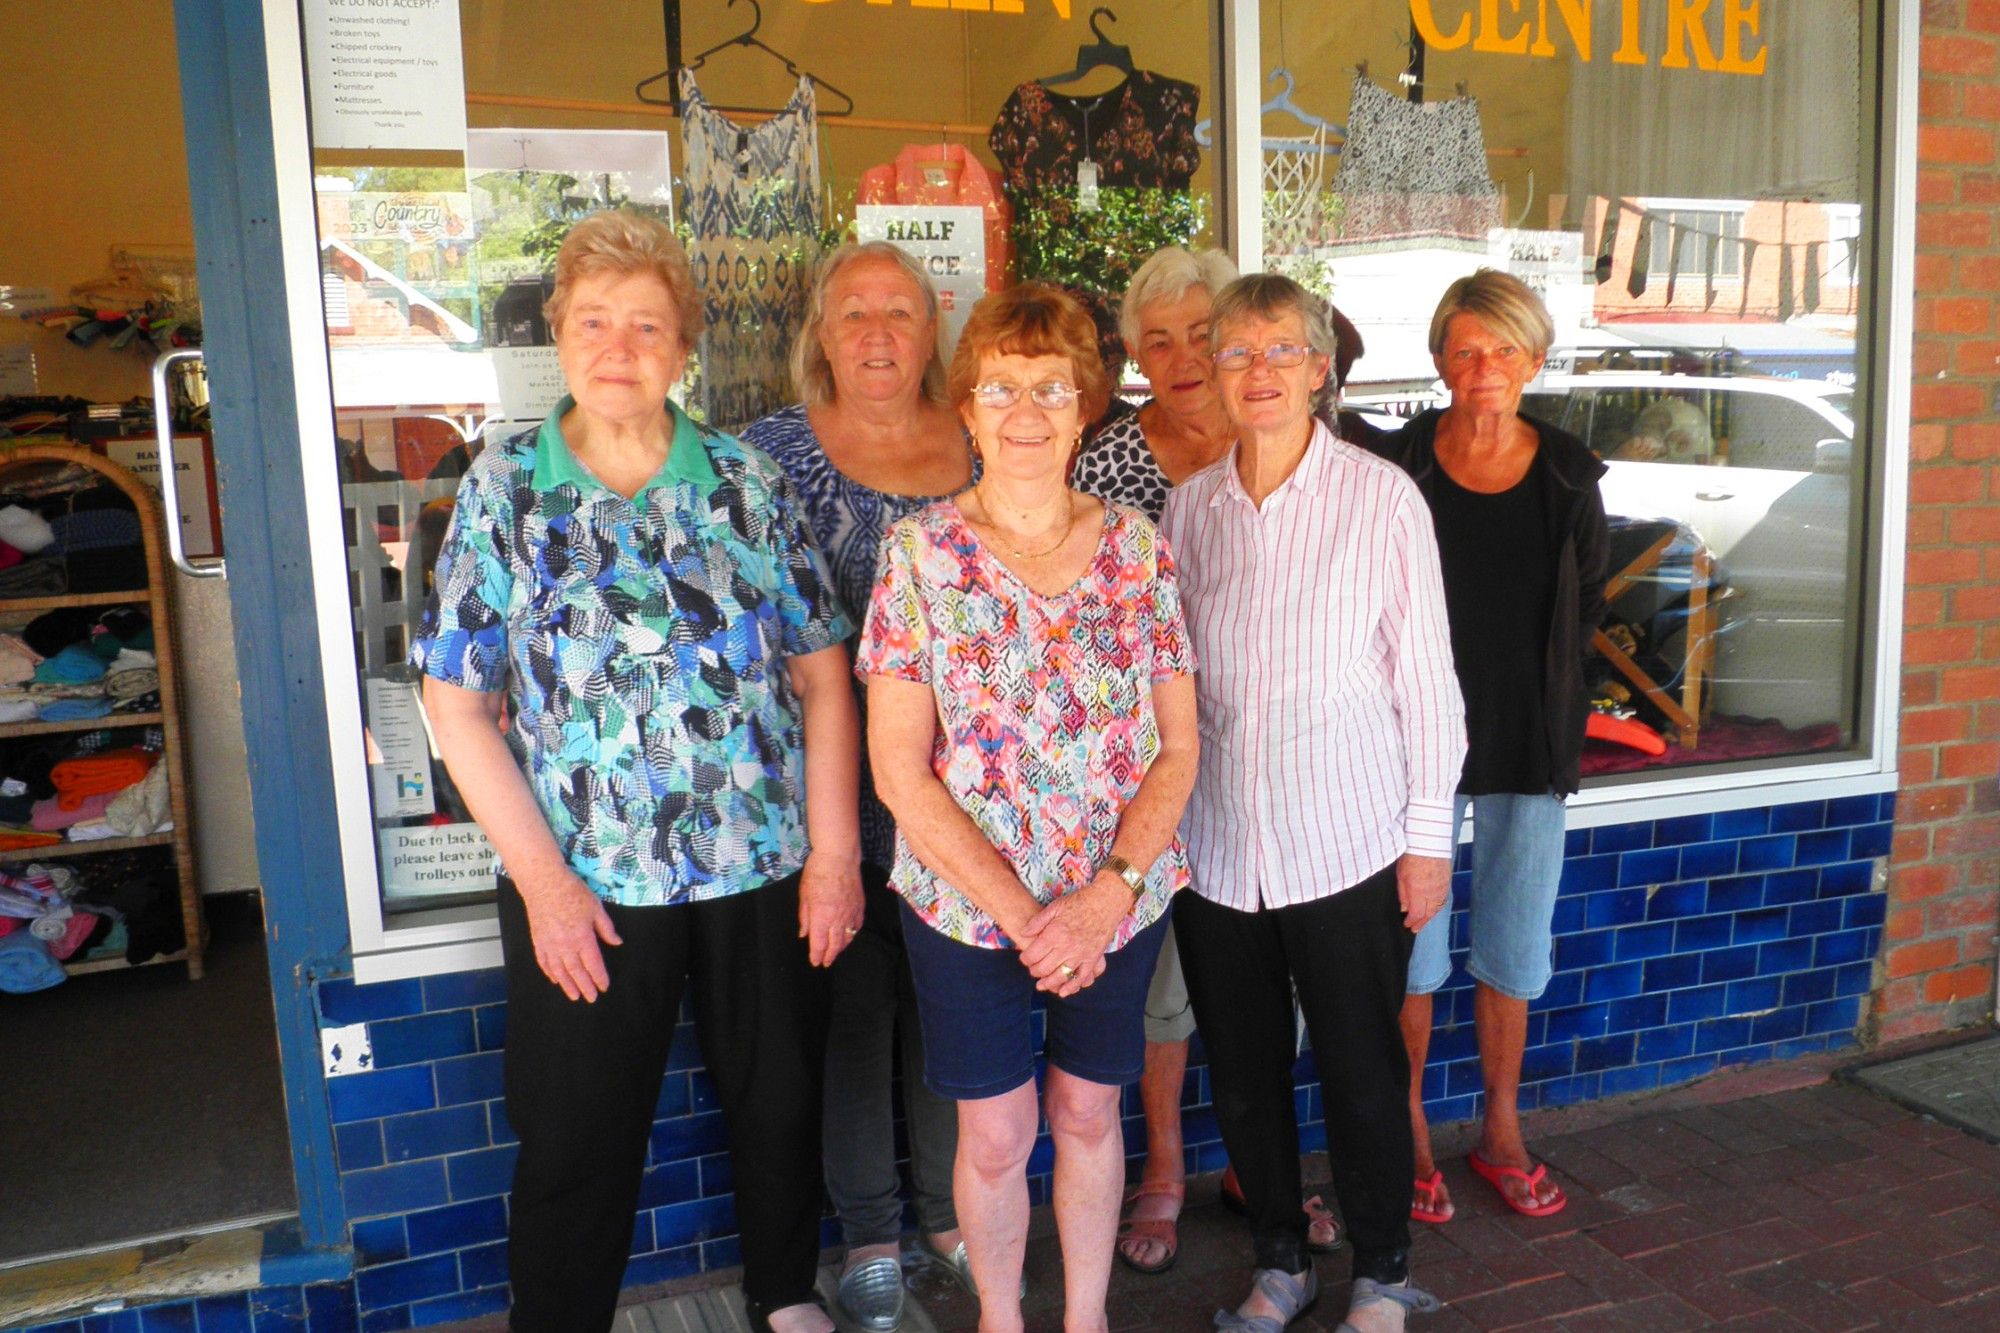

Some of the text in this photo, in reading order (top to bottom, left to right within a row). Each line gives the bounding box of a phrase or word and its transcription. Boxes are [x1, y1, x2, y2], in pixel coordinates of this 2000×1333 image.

[364, 31, 381, 39] toys
[1410, 0, 1768, 75] CENTRE
[336, 43, 402, 53] Chipped crockery
[373, 58, 415, 66] equipment
[423, 59, 439, 67] toys
[374, 71, 397, 79] goods
[338, 83, 374, 91] Furniture
[339, 96, 382, 104] Mattresses
[373, 200, 442, 230] Country
[333, 223, 368, 234] 2023
[885, 220, 955, 241] HALF
[511, 350, 559, 359] Saturda
[398, 835, 426, 848] Due
[430, 836, 443, 847] to
[447, 832, 475, 845] lack
[394, 852, 436, 868] please
[440, 850, 474, 863] leave
[415, 867, 465, 882] trolleys
